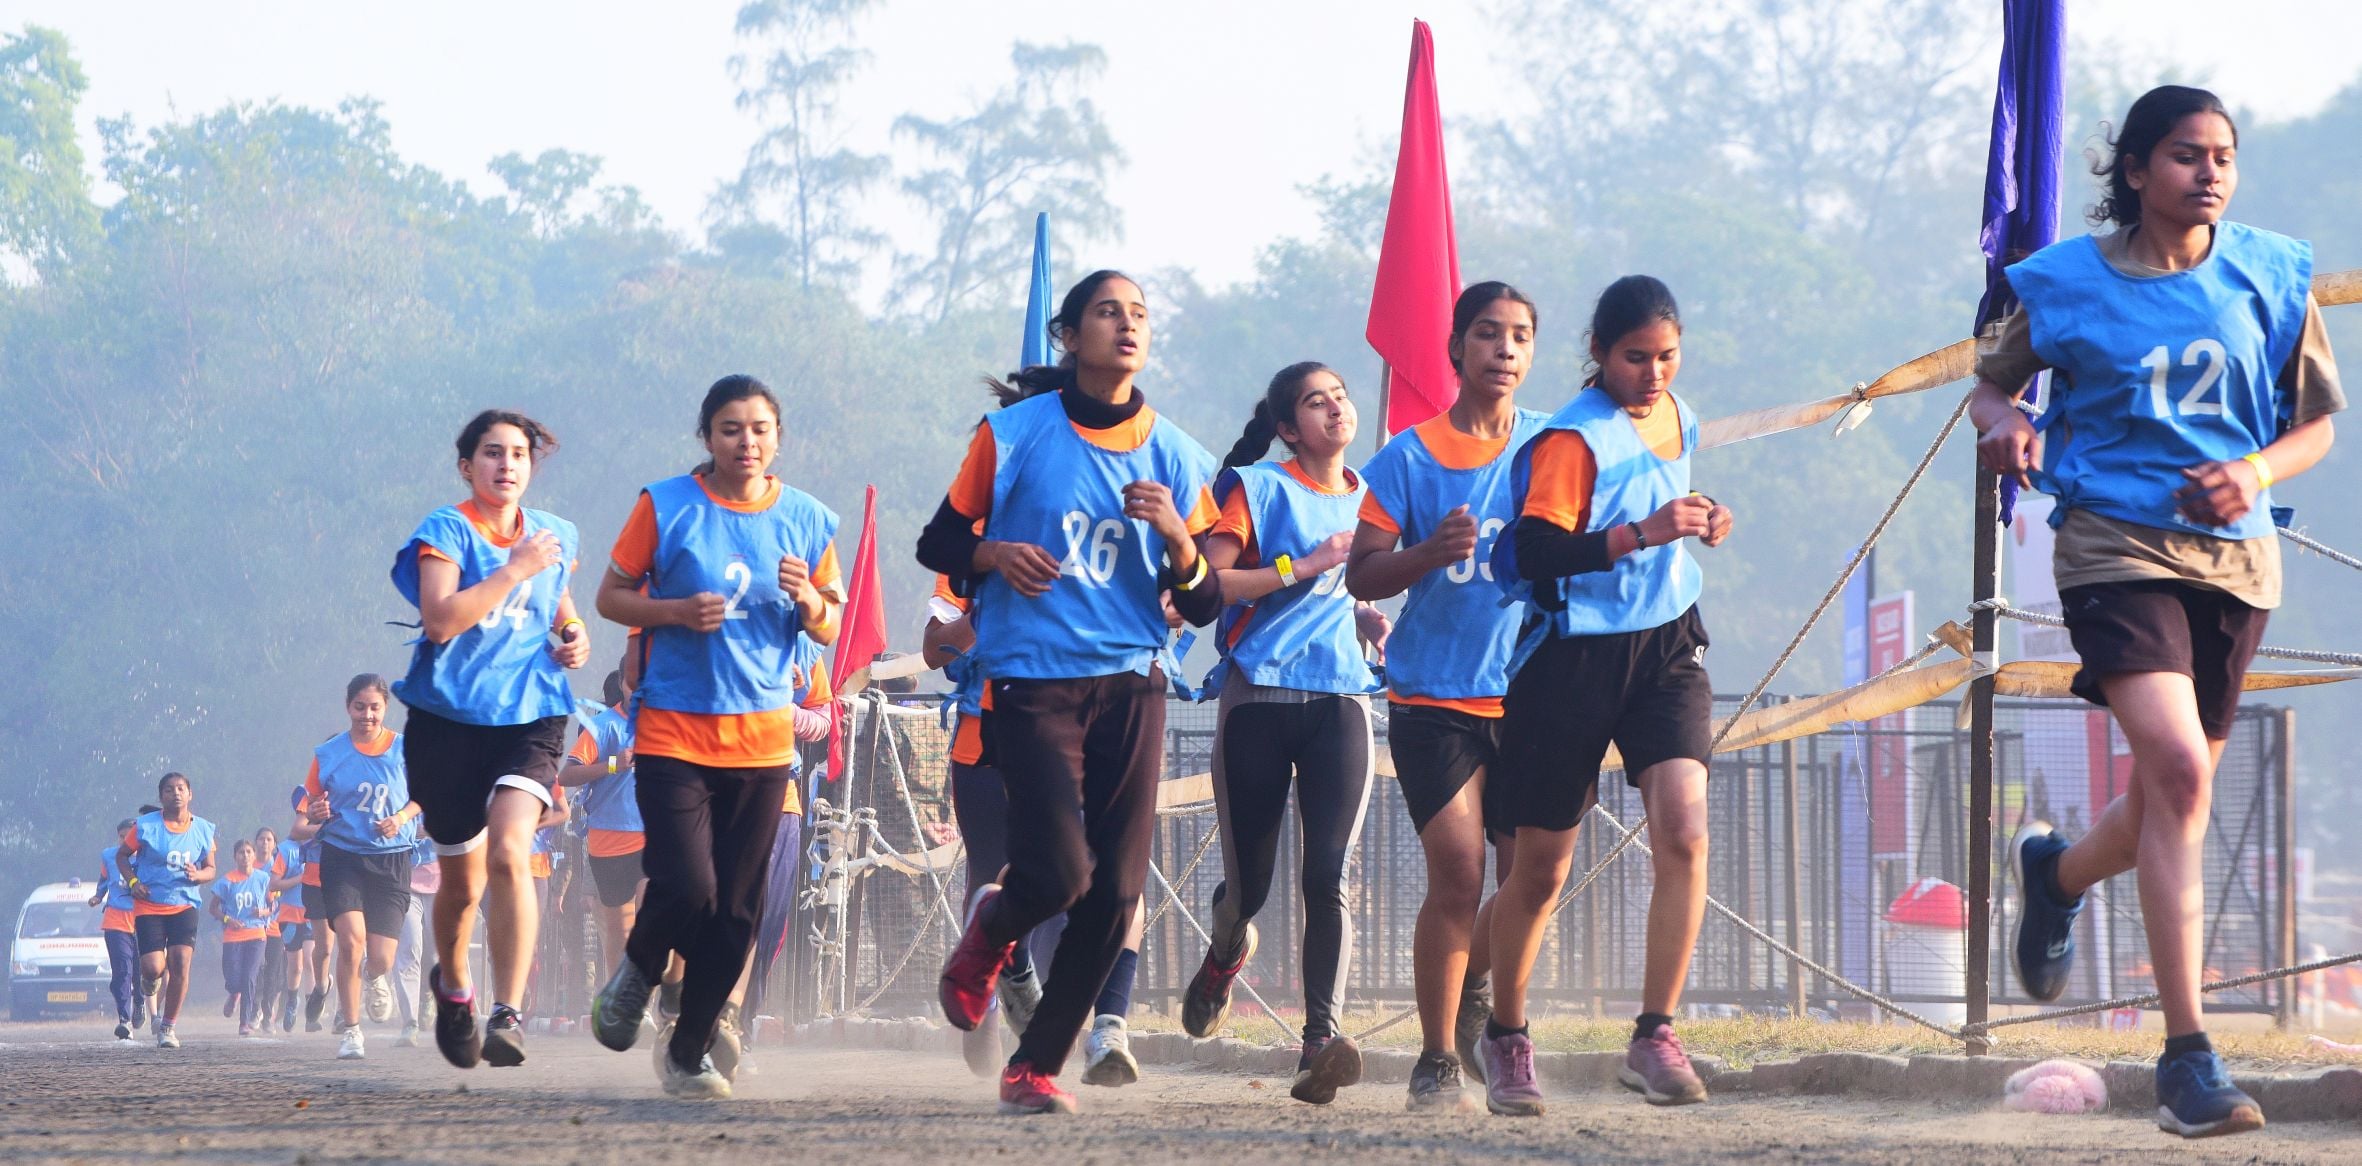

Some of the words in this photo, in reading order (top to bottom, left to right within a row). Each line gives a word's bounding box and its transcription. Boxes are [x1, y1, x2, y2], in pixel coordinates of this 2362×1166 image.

[2140, 338, 2227, 419] 12
[1059, 510, 1125, 588] 26
[725, 561, 751, 619] 2
[357, 782, 389, 814] 28
